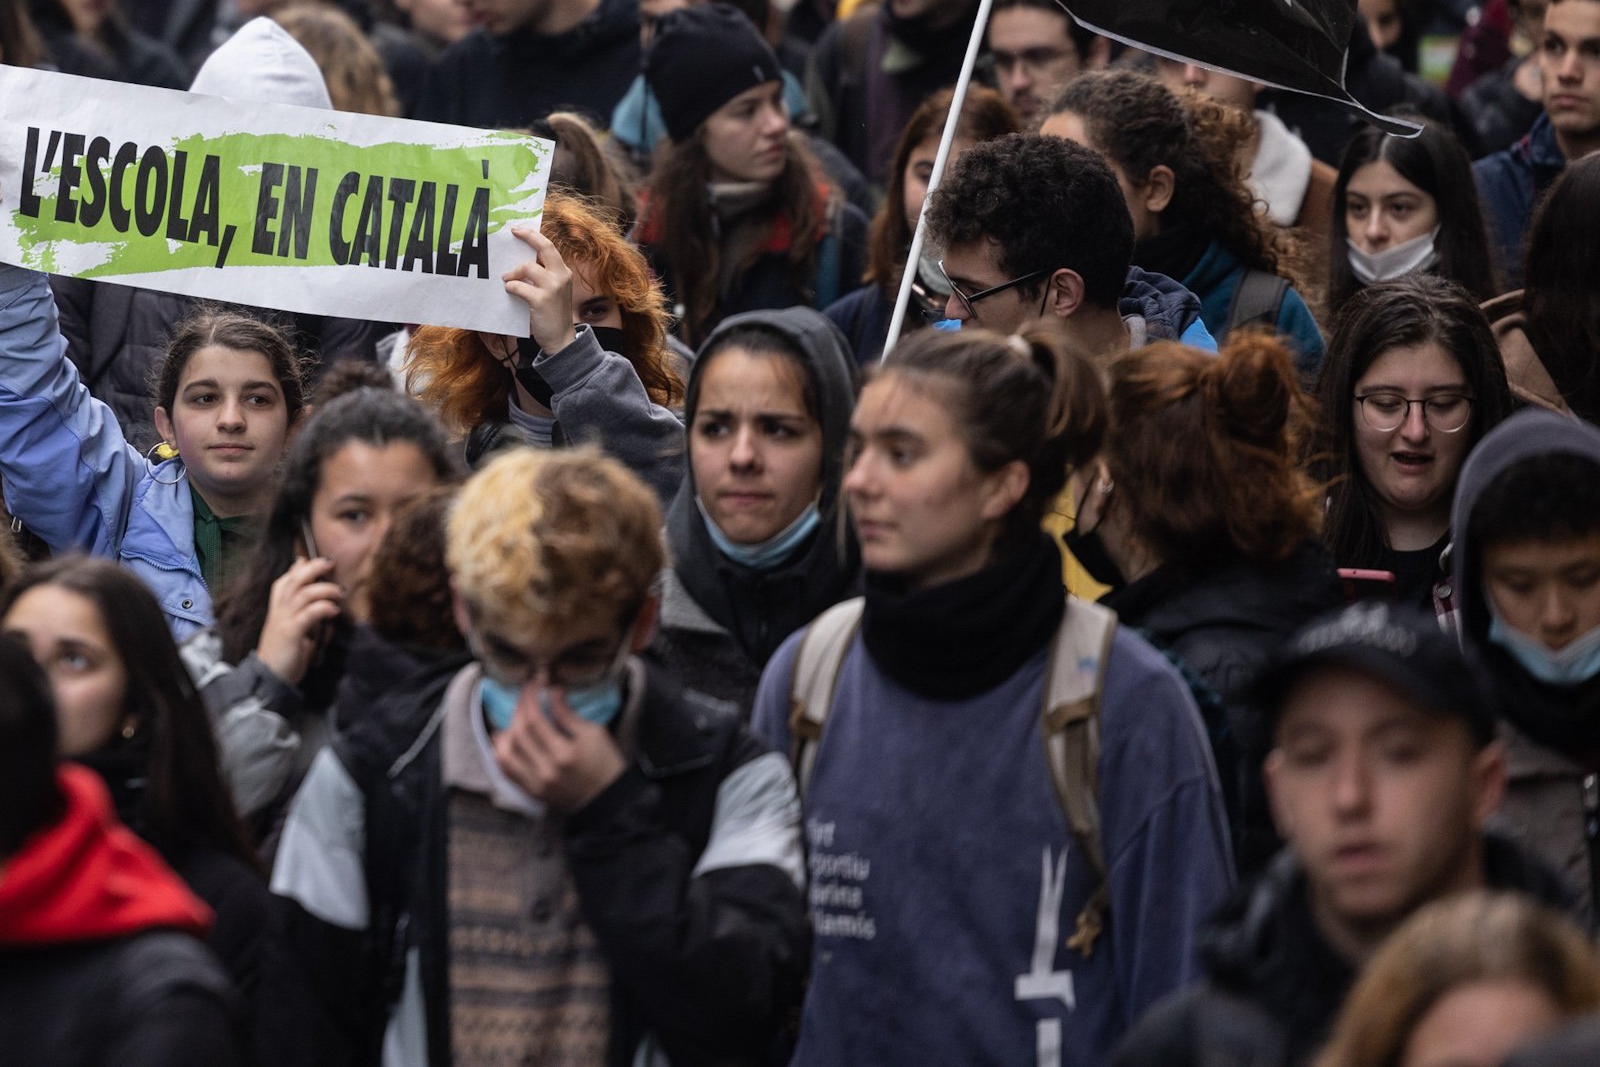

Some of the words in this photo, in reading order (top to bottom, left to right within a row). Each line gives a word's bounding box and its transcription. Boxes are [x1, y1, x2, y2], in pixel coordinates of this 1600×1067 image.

[20, 126, 238, 269] L'ESCOLA,
[251, 162, 319, 260] EN
[329, 160, 490, 279] CATALÀ
